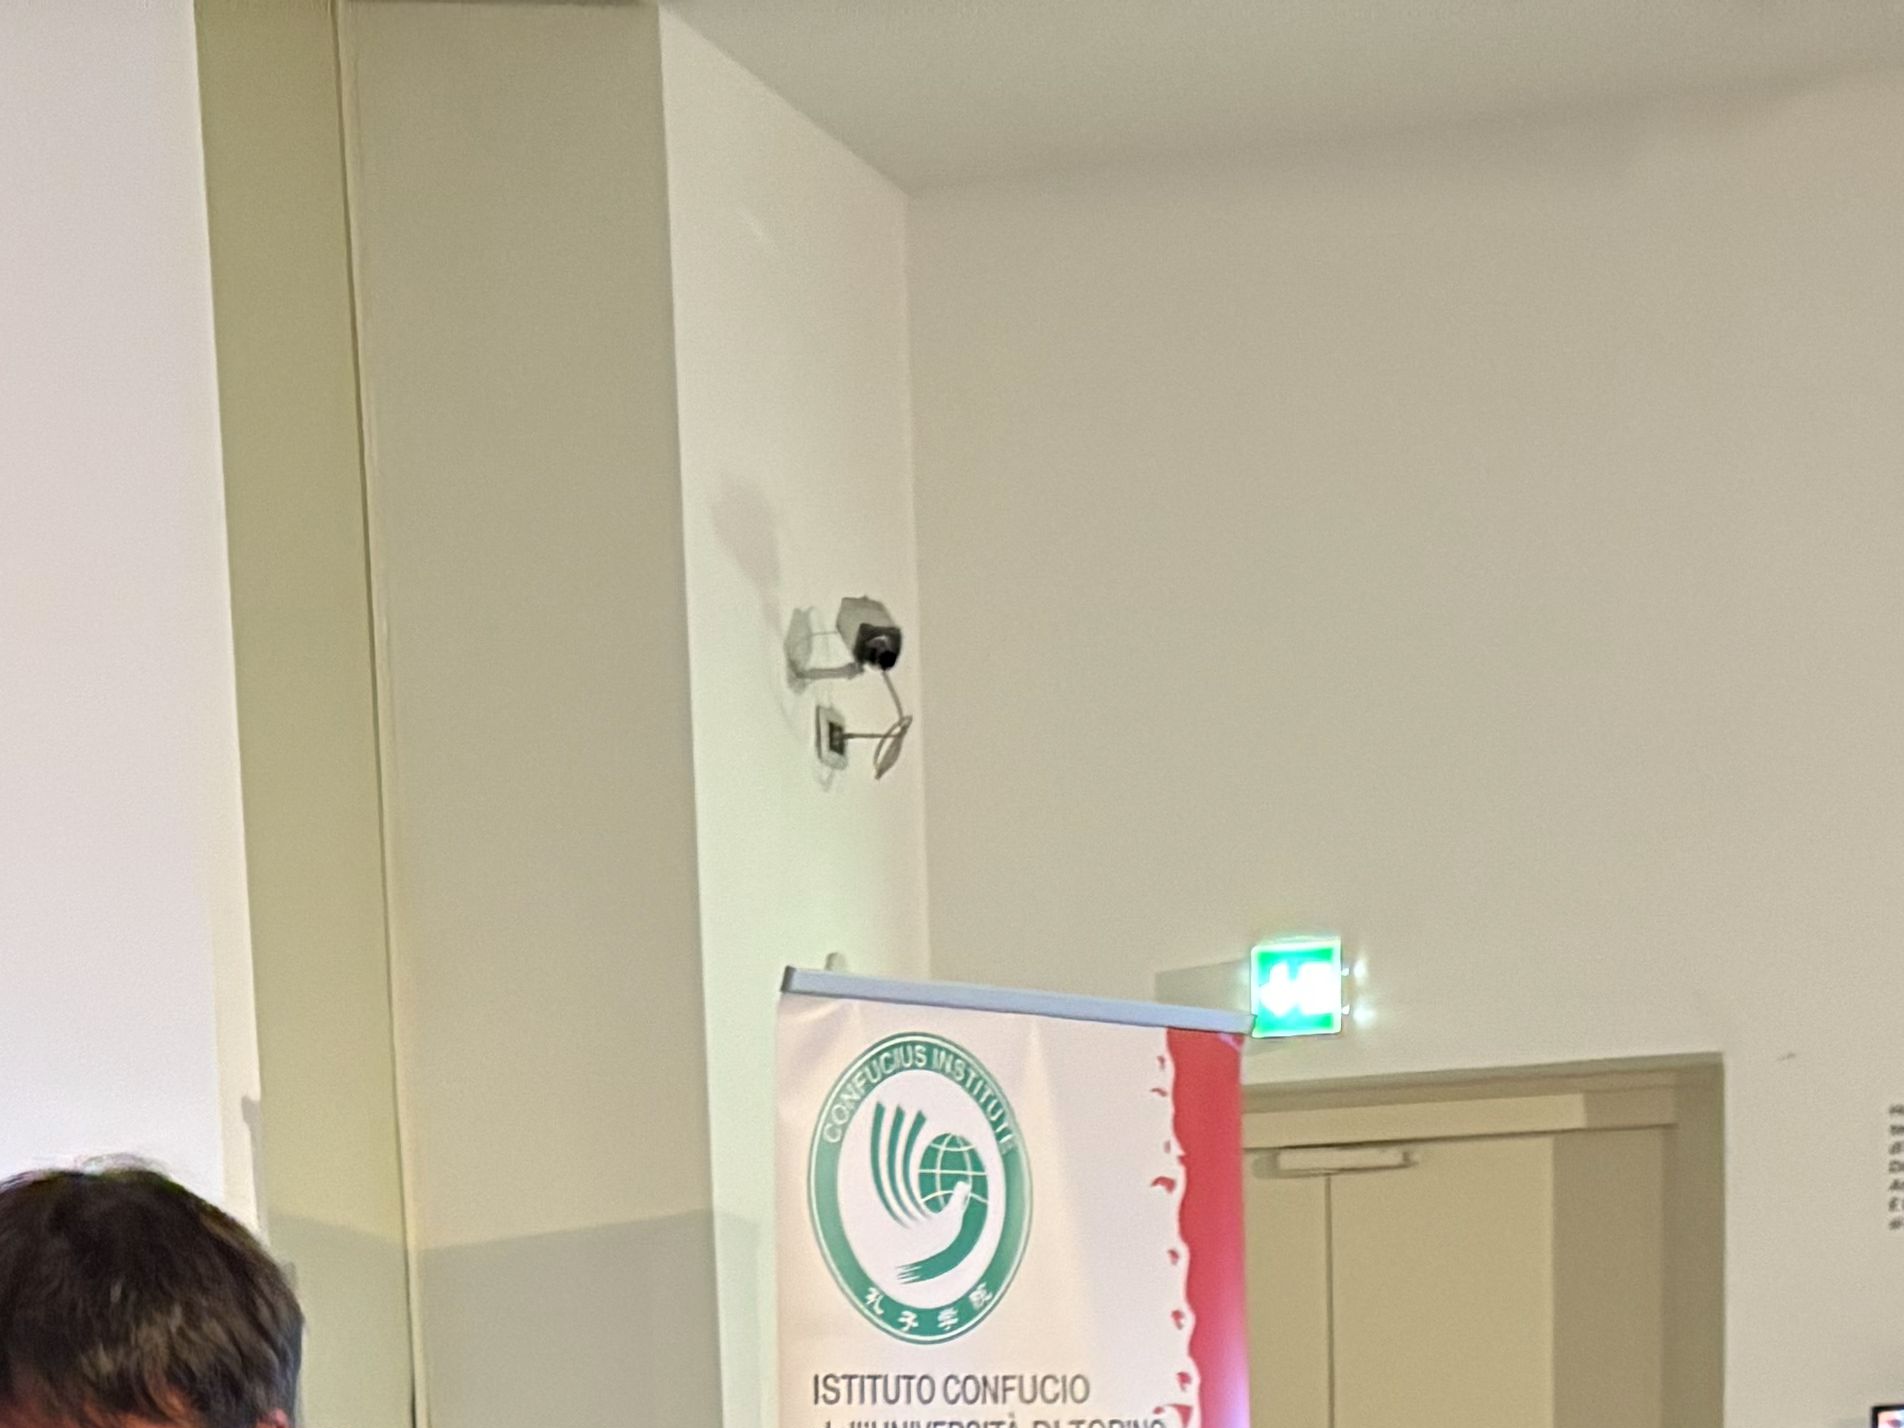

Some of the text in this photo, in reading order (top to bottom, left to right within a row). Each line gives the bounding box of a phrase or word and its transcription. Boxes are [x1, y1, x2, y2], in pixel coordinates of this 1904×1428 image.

[823, 1045, 1017, 1155] CONFUCIUS INSTITUTE
[813, 1373, 1091, 1406] ISTITUTO CONFUCIO
